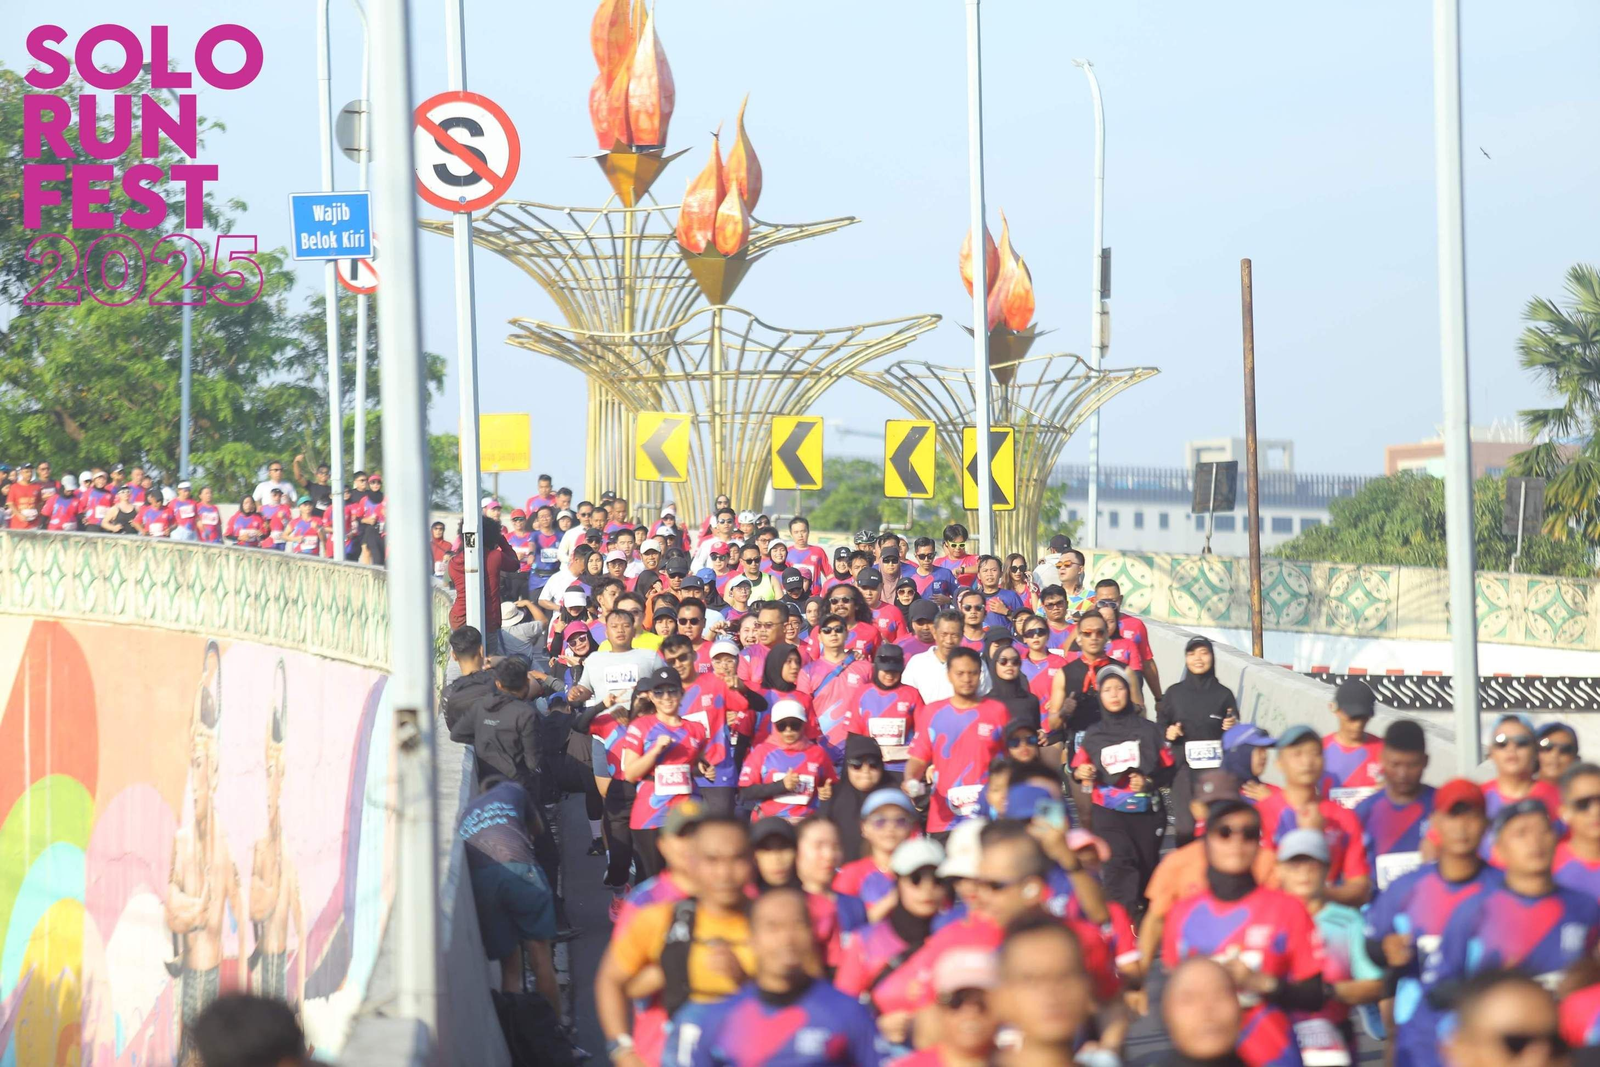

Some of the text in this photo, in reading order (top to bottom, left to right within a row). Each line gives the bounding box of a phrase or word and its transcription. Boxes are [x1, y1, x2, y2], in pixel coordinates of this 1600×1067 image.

[432, 116, 488, 187] S
[312, 202, 351, 226] Wajib
[300, 229, 365, 250] Belok Kiri
